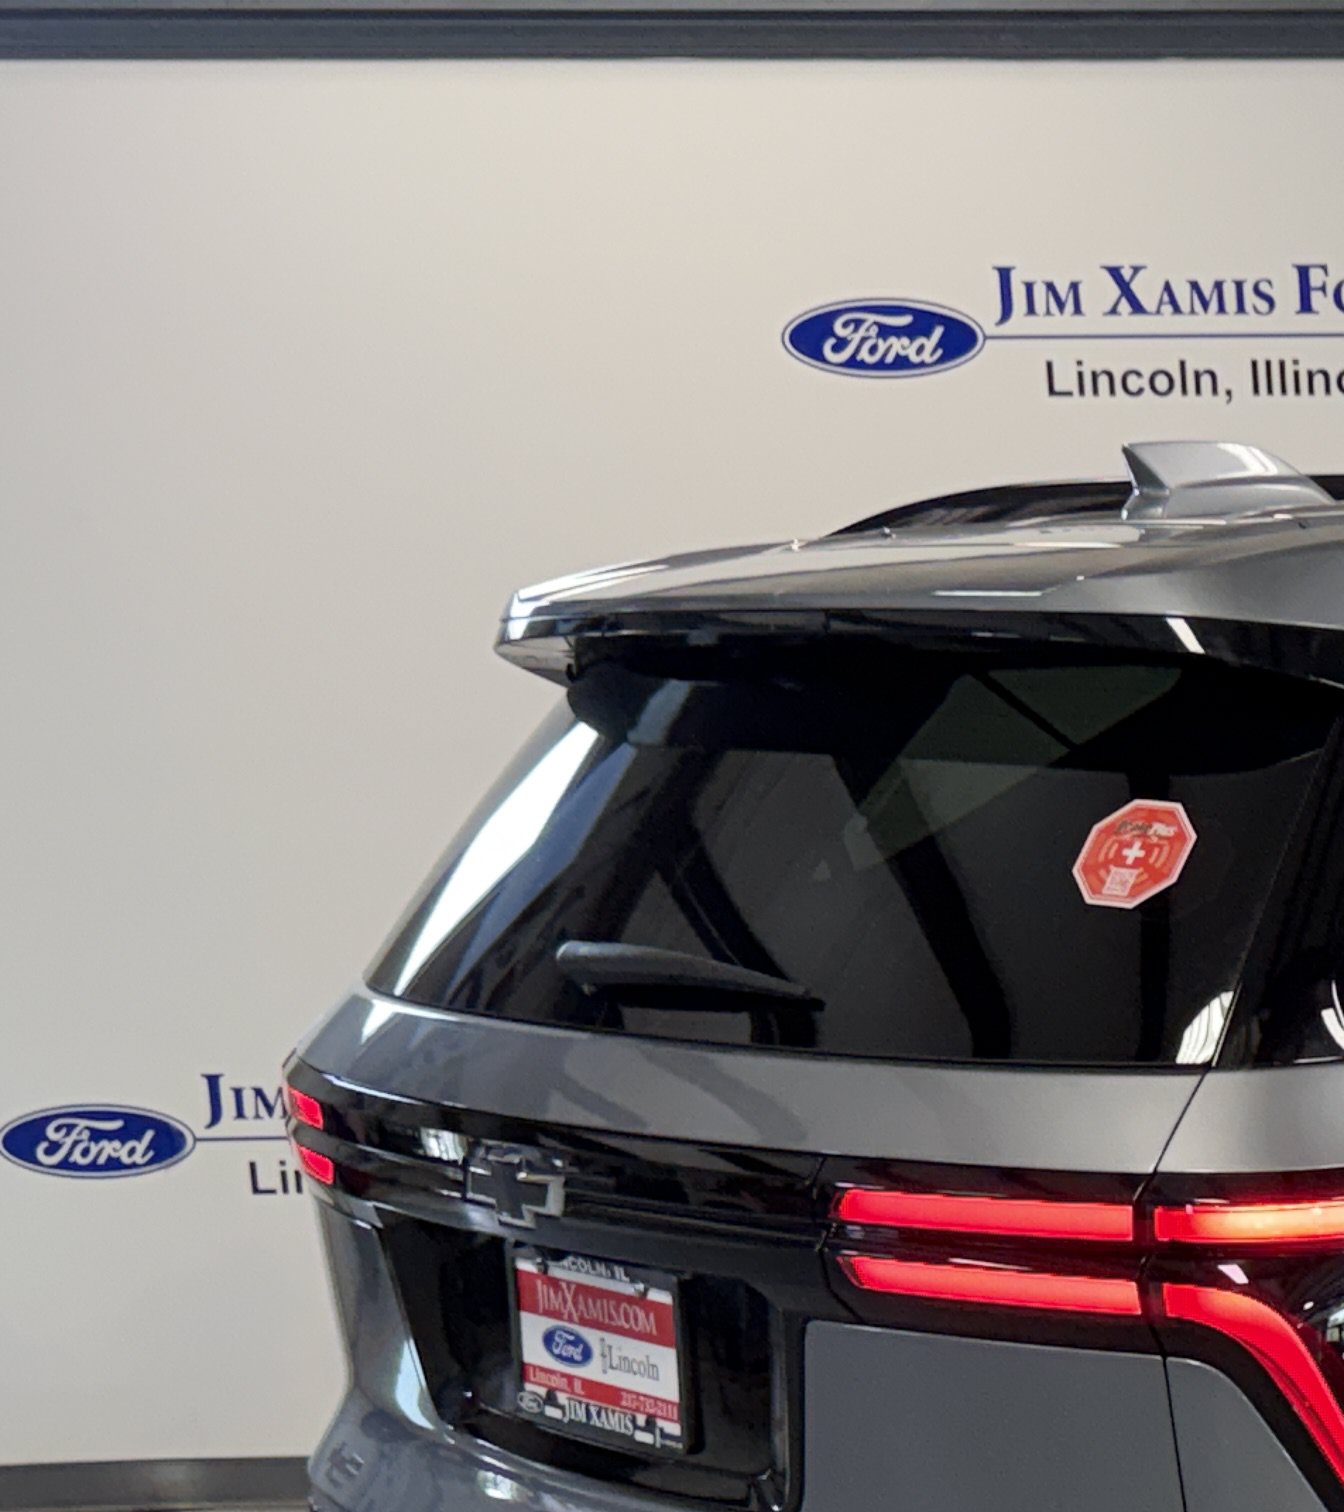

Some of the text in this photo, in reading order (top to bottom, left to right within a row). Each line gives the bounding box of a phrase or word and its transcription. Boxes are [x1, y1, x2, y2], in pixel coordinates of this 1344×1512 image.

[992, 265, 1084, 327] JIM
[1099, 264, 1277, 317] XAMIS
[822, 311, 944, 365] Ford
[1045, 358, 1233, 404] Lincoln,
[35, 1116, 156, 1166] Ford
[551, 1329, 584, 1362] Ford
[608, 1344, 660, 1382] Lincoln
[563, 1397, 588, 1424] JIM
[589, 1405, 635, 1436] XAMIS
